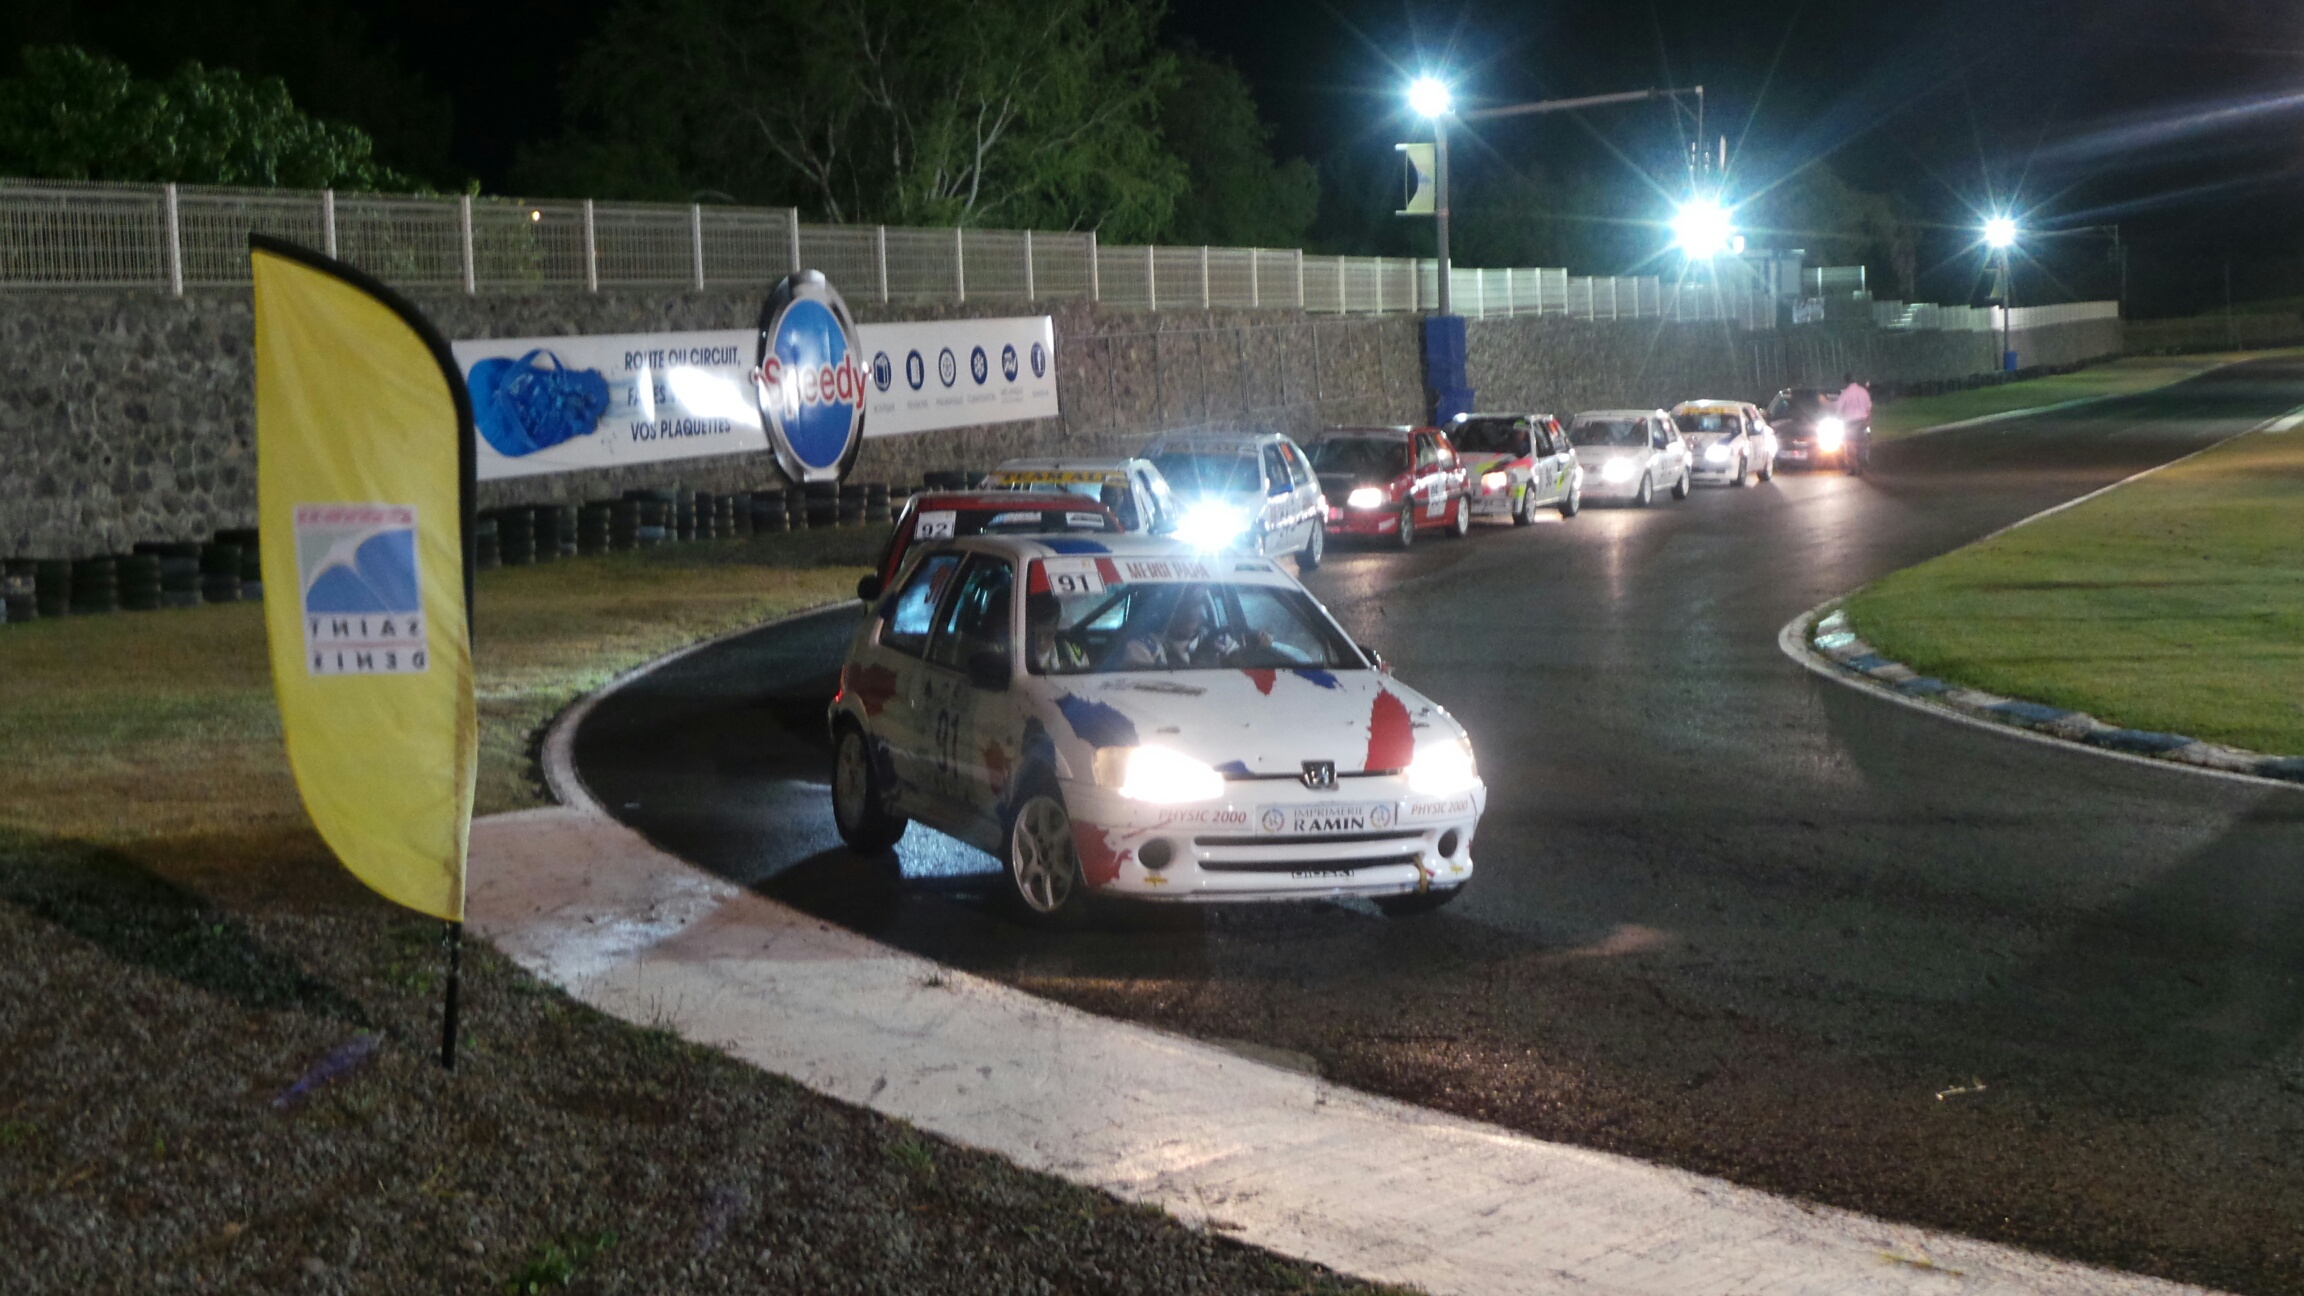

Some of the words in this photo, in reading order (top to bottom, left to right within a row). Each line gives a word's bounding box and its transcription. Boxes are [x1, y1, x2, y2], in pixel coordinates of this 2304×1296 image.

[625, 350, 665, 370] ROUTE
[690, 346, 742, 367] CIRCUIT,
[628, 385, 666, 406] FES
[631, 420, 657, 441] VOS
[661, 417, 732, 439] PLAQUETTES
[921, 523, 948, 537] 92
[1058, 573, 1090, 592] 91
[935, 707, 961, 780] 91
[1158, 807, 1210, 822] PHYSIC
[1212, 810, 1247, 823] 2000
[1411, 801, 1447, 816] PHYSIC
[1448, 799, 1469, 813] 2000
[1294, 816, 1365, 832] RAMIN
